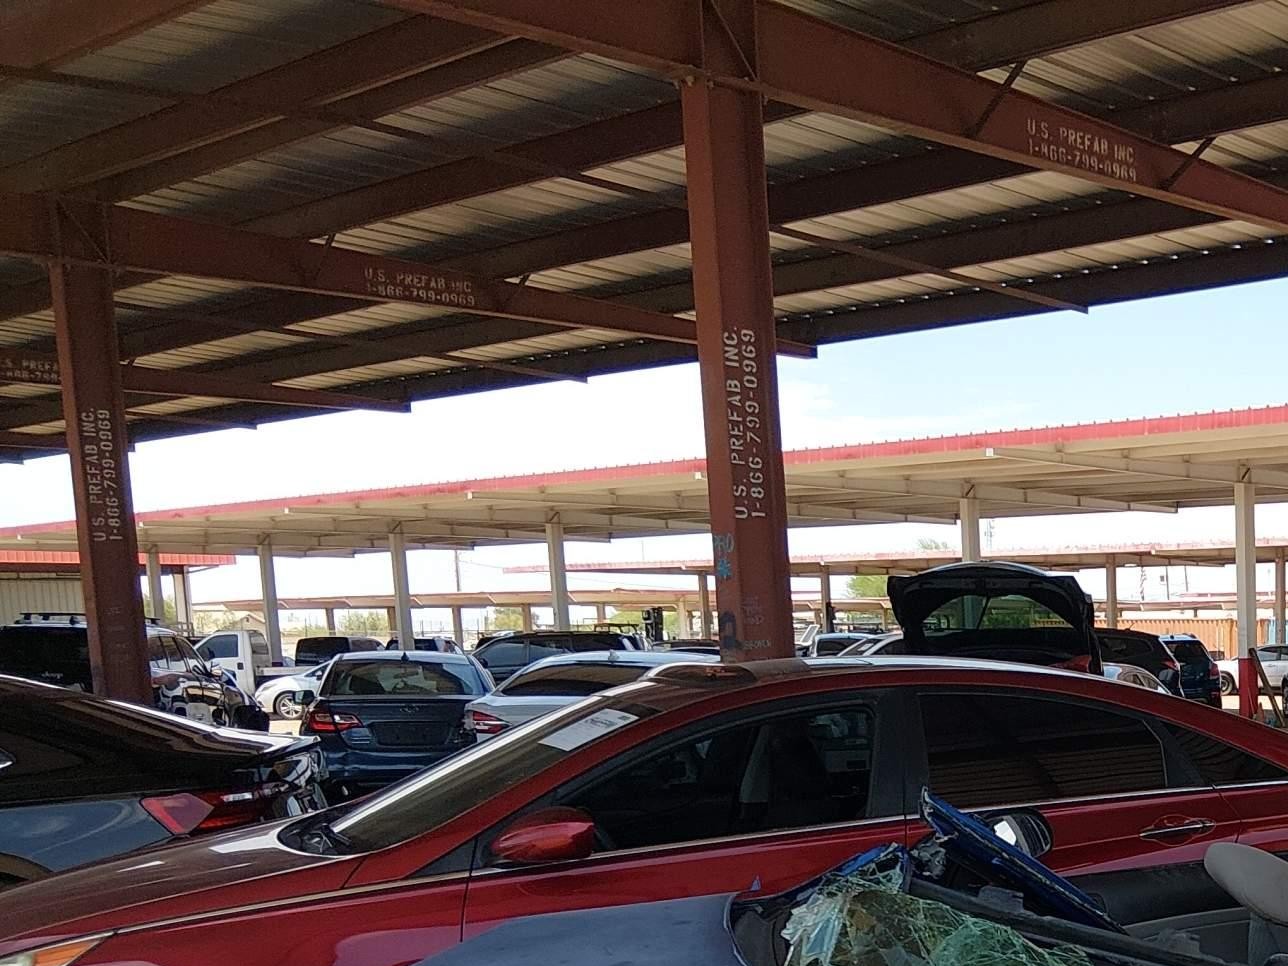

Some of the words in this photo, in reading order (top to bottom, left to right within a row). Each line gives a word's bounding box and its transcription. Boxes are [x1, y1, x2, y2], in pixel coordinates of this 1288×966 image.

[1027, 119, 1053, 141] U.S.
[1059, 127, 1108, 155] PREFAB
[396, 272, 446, 290] PREFAB
[723, 326, 740, 367] INC.
[81, 407, 97, 437] INC.
[726, 379, 746, 465] PREFAB
[741, 328, 767, 518] 1-866-799-0969
[84, 443, 104, 504] PREFAB
[97, 408, 123, 540] 1-866-799-0969
[734, 478, 749, 519] U.S.
